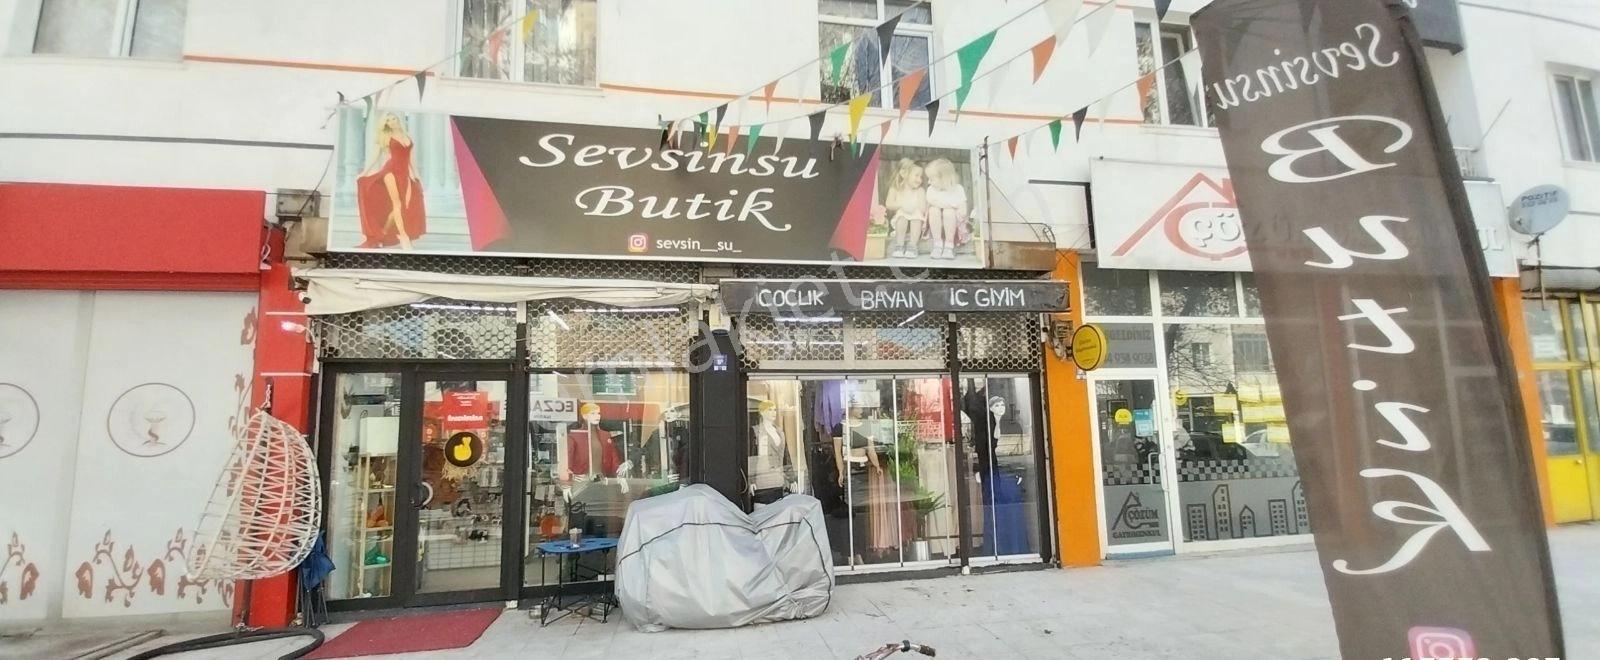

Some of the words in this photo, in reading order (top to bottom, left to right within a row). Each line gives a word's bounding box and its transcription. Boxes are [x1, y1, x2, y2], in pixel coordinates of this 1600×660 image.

[518, 133, 820, 179] Sevsinsu
[575, 185, 792, 231] Butik
[861, 290, 923, 310] BAYAN
